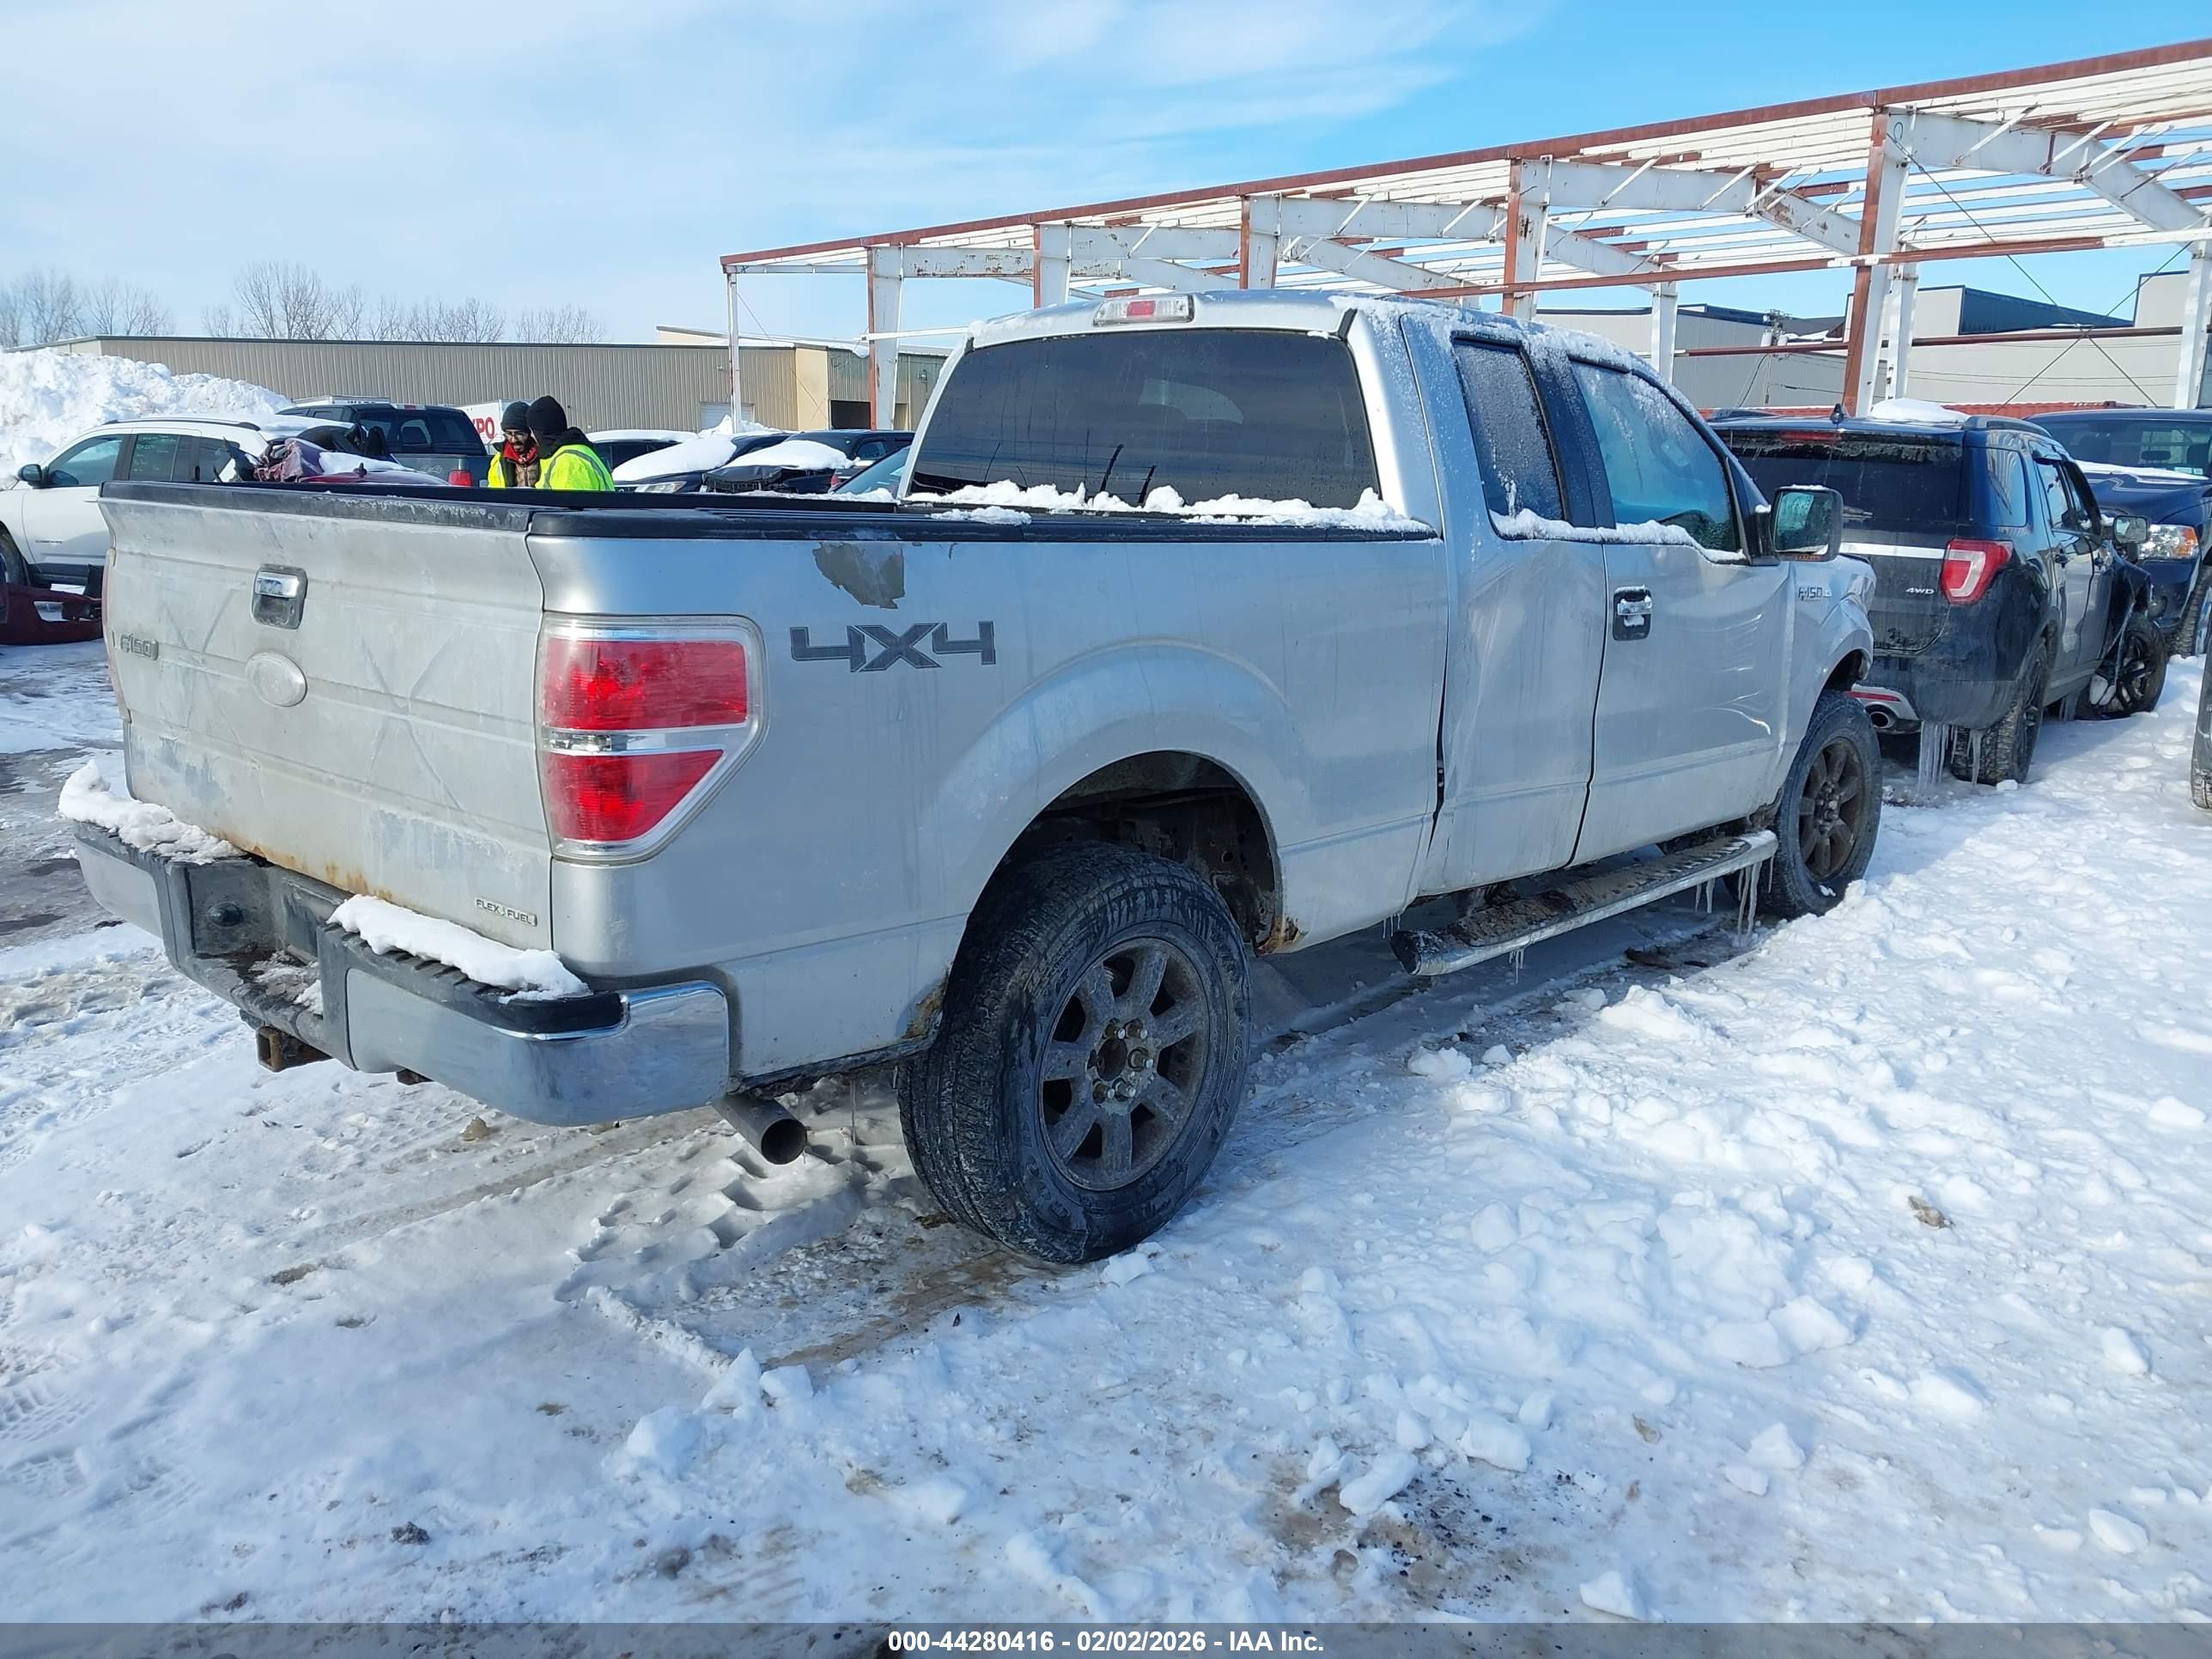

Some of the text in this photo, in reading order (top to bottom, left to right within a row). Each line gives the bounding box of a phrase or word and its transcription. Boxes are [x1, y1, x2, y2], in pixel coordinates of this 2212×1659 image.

[472, 416, 495, 439] PO
[789, 620, 996, 672] 4X4
[476, 898, 532, 925] FLEX FUEL
